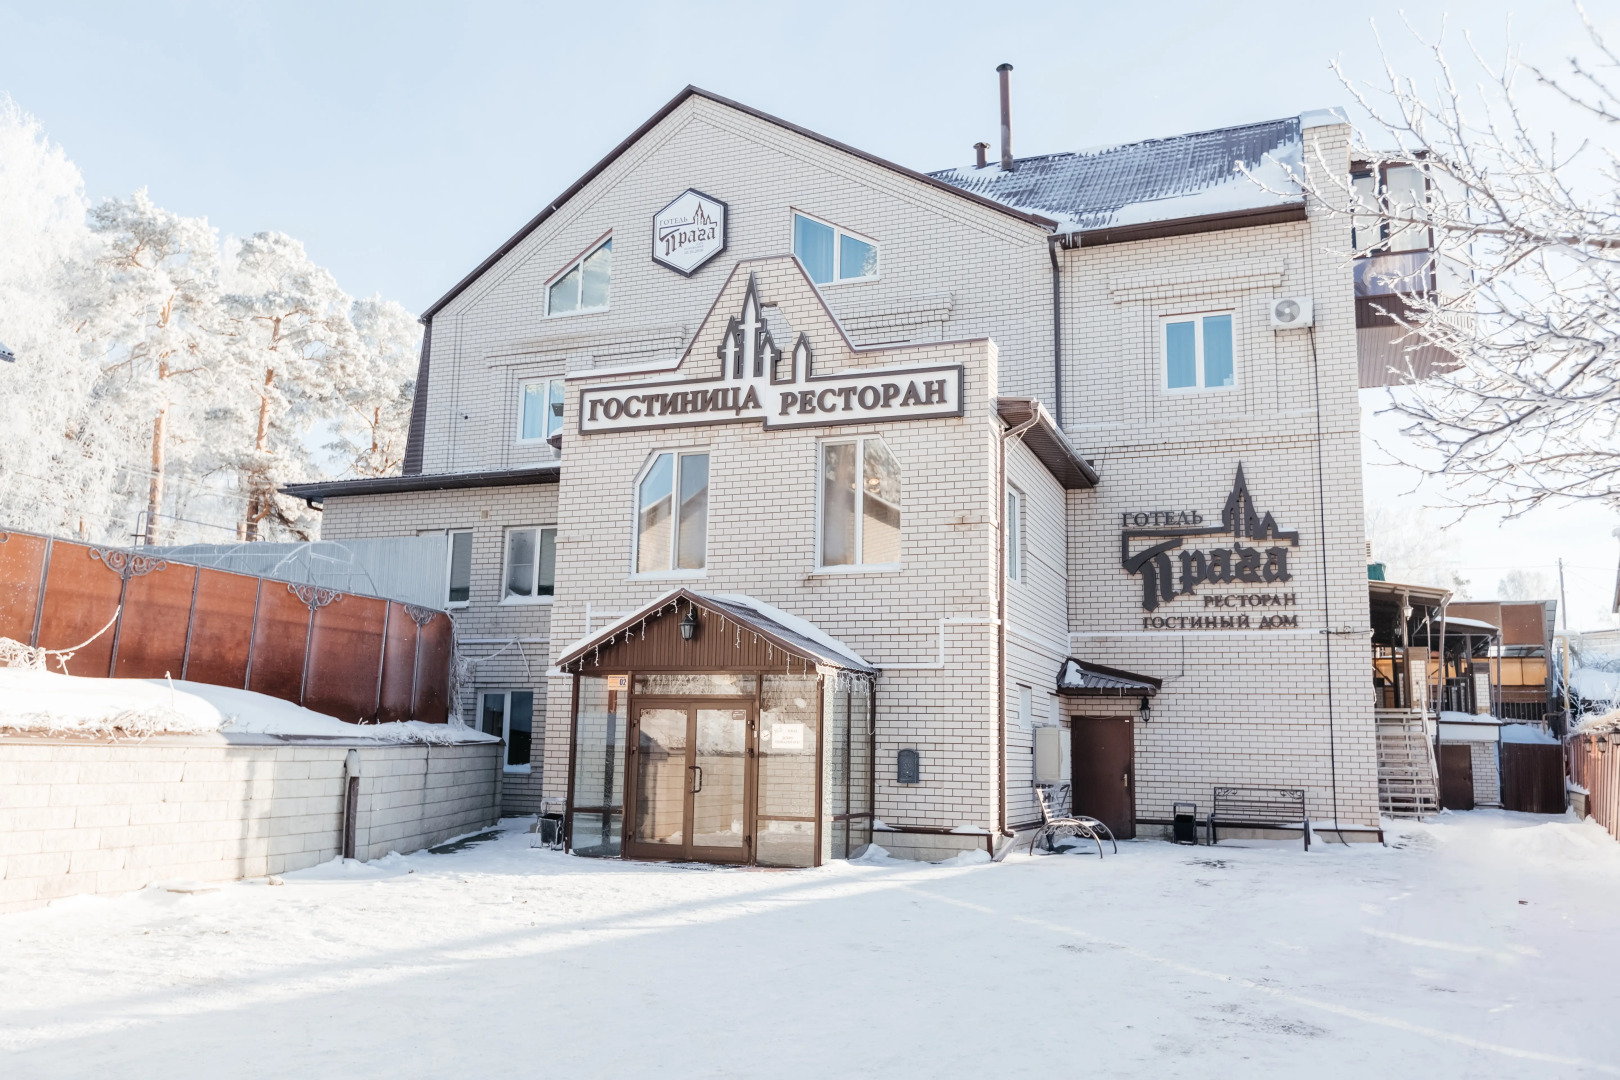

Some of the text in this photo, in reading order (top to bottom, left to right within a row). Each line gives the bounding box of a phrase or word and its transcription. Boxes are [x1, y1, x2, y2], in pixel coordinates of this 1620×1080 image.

[659, 227, 715, 256] Прага
[588, 379, 947, 421] ГОСТИНИЦА РЕСТОРАН
[1122, 510, 1204, 527] ГОТЕЛЬ
[1122, 538, 1293, 613] Прага
[1203, 593, 1297, 607] РЕСТОРАН
[1143, 613, 1299, 630] ГОСТИНЫЙ ДОМ
